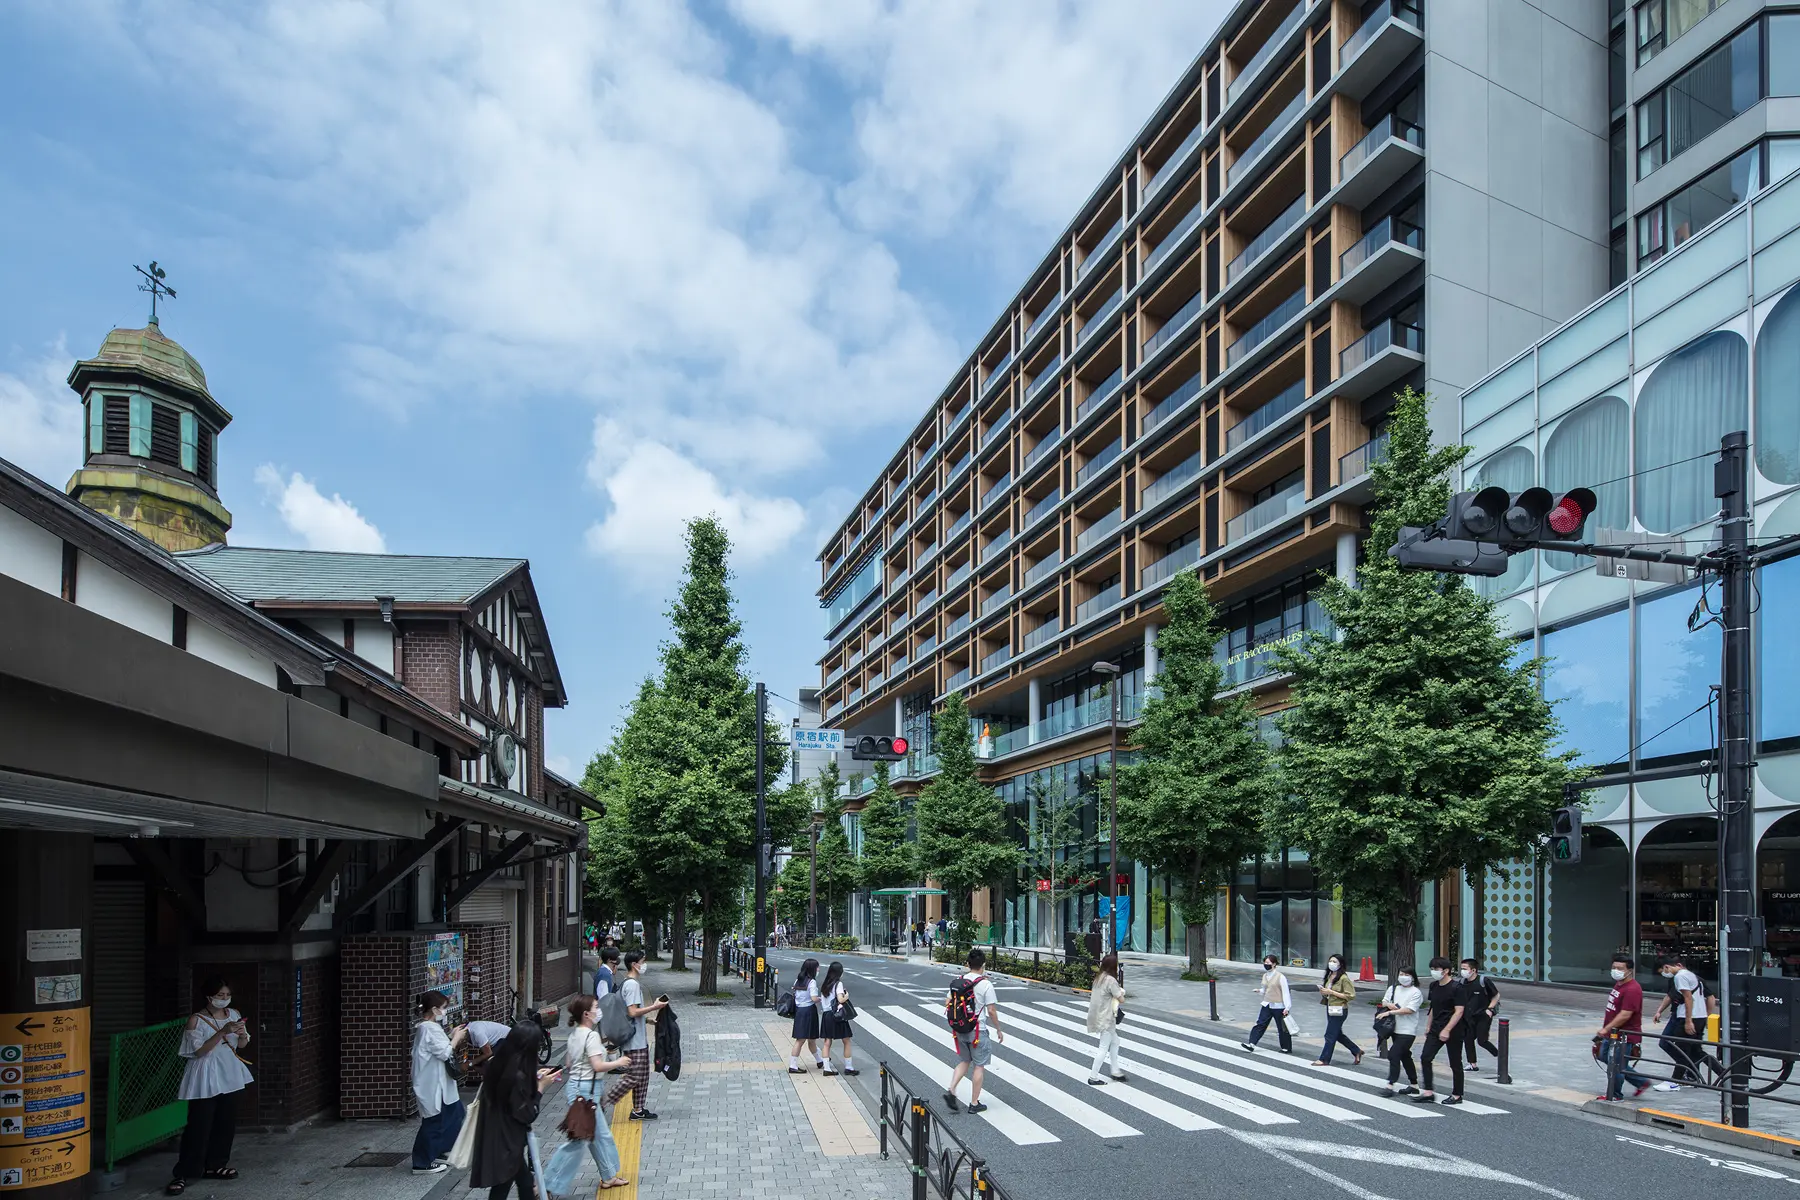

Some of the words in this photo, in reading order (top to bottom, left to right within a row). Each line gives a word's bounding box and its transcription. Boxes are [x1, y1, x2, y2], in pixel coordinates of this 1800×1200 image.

[1226, 653, 1241, 666] AUX
[795, 731, 840, 743] 原宿駅前
[1756, 995, 1783, 1004] 332-34
[52, 1016, 74, 1025] 左へ
[24, 1041, 63, 1051] 千代田線
[24, 1085, 62, 1096] 明治神宮
[25, 1111, 71, 1123] 代々木公園
[30, 1147, 52, 1156] 右へ
[34, 1154, 53, 1163] right
[25, 1161, 72, 1177] 竹下通り
[27, 1174, 58, 1182] Takeshita
[59, 1169, 75, 1177] street
